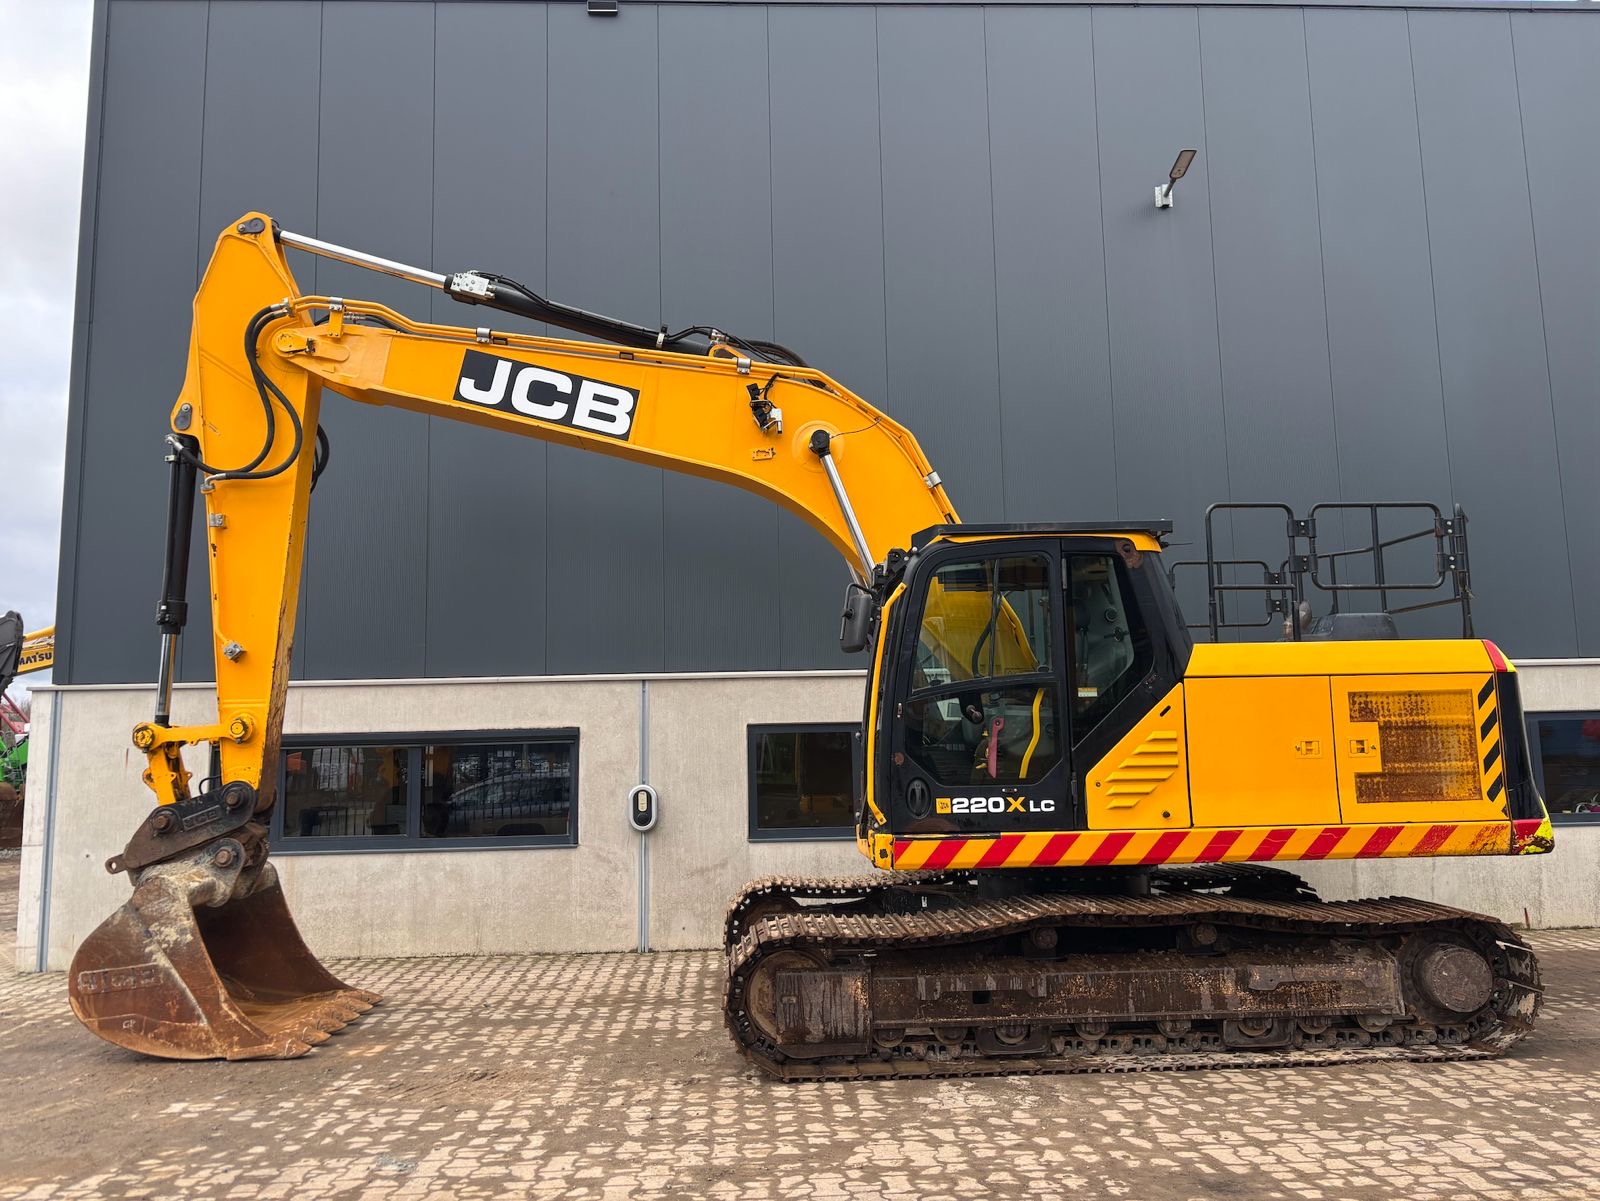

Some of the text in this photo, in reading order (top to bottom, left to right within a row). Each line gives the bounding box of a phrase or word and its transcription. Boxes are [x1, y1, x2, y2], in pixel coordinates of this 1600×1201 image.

[459, 359, 634, 435] JCB
[952, 797, 1026, 813] 220X
[1029, 800, 1055, 812] LC
